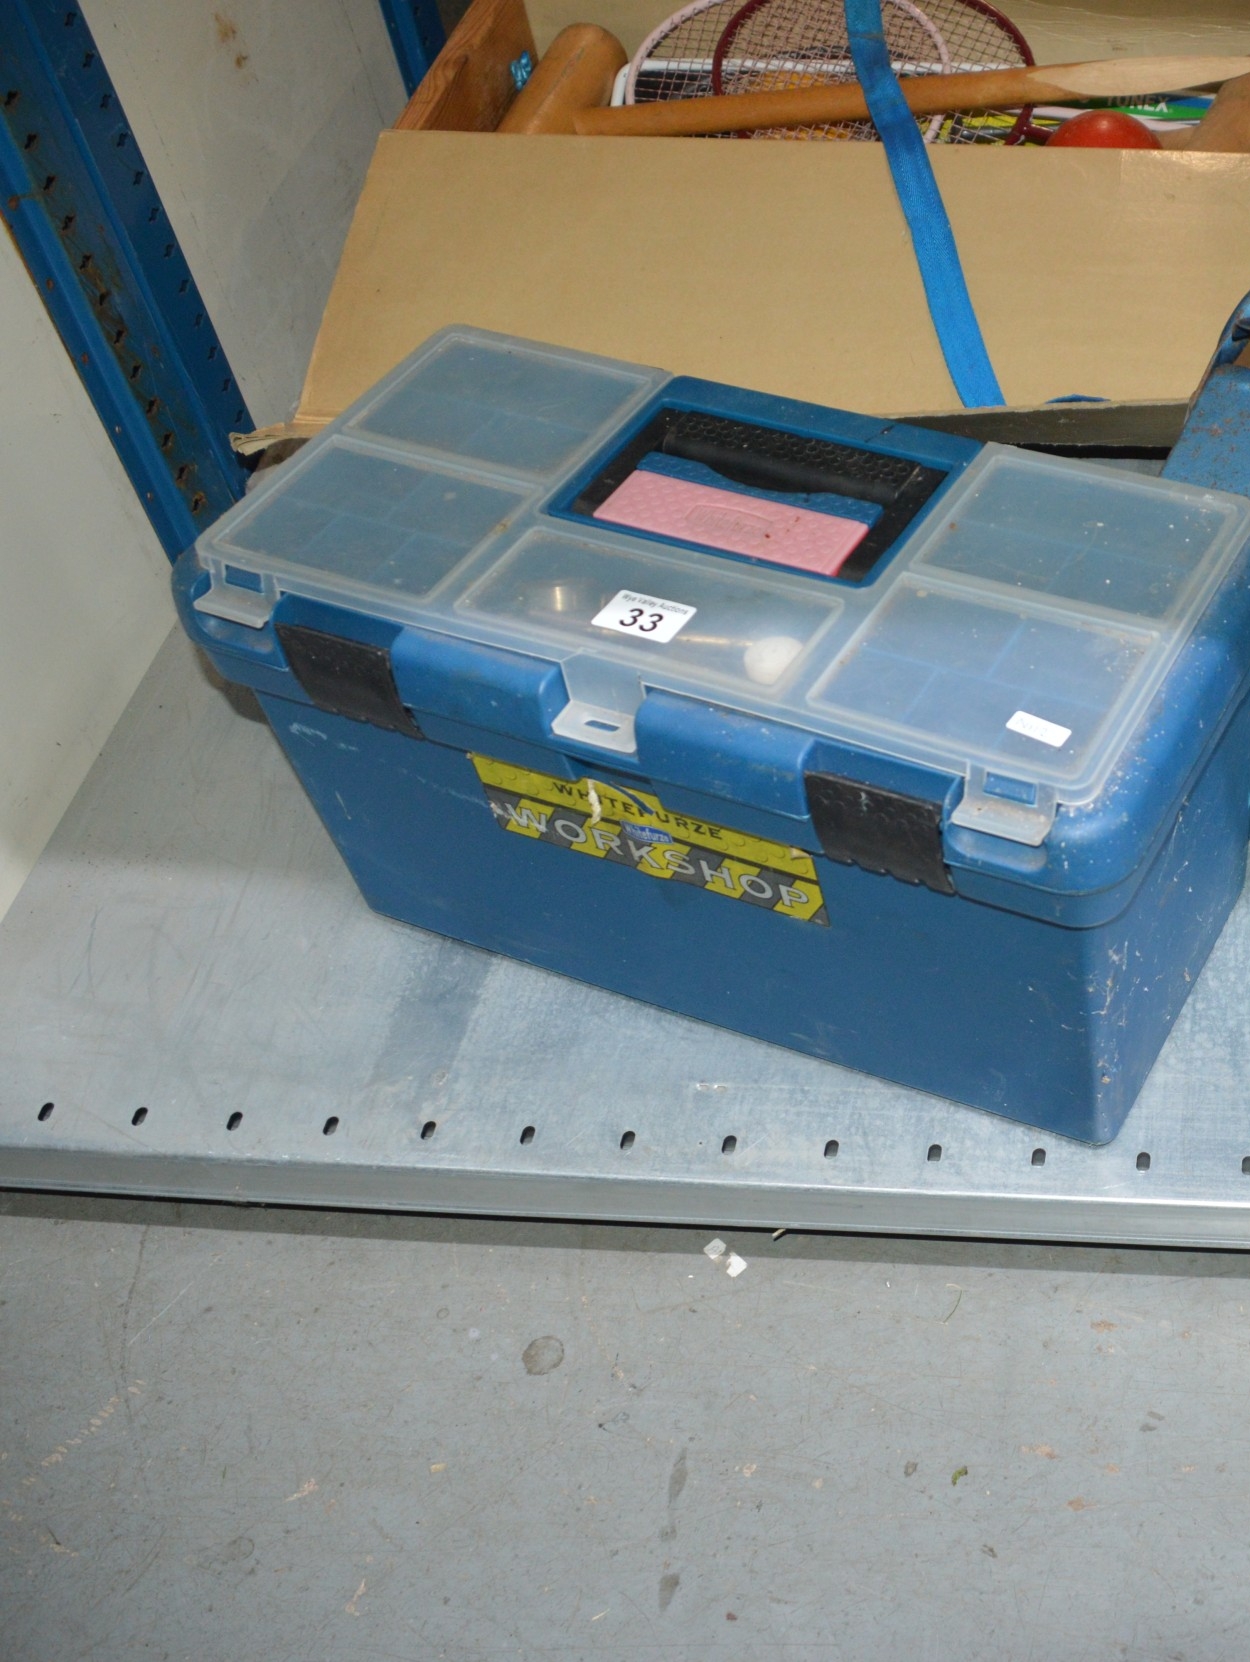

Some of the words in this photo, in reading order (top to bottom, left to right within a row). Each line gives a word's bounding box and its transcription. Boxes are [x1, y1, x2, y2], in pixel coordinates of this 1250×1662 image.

[619, 608, 664, 632] 33
[659, 602, 689, 615] Auctions
[506, 802, 810, 908] WORKSHOP
